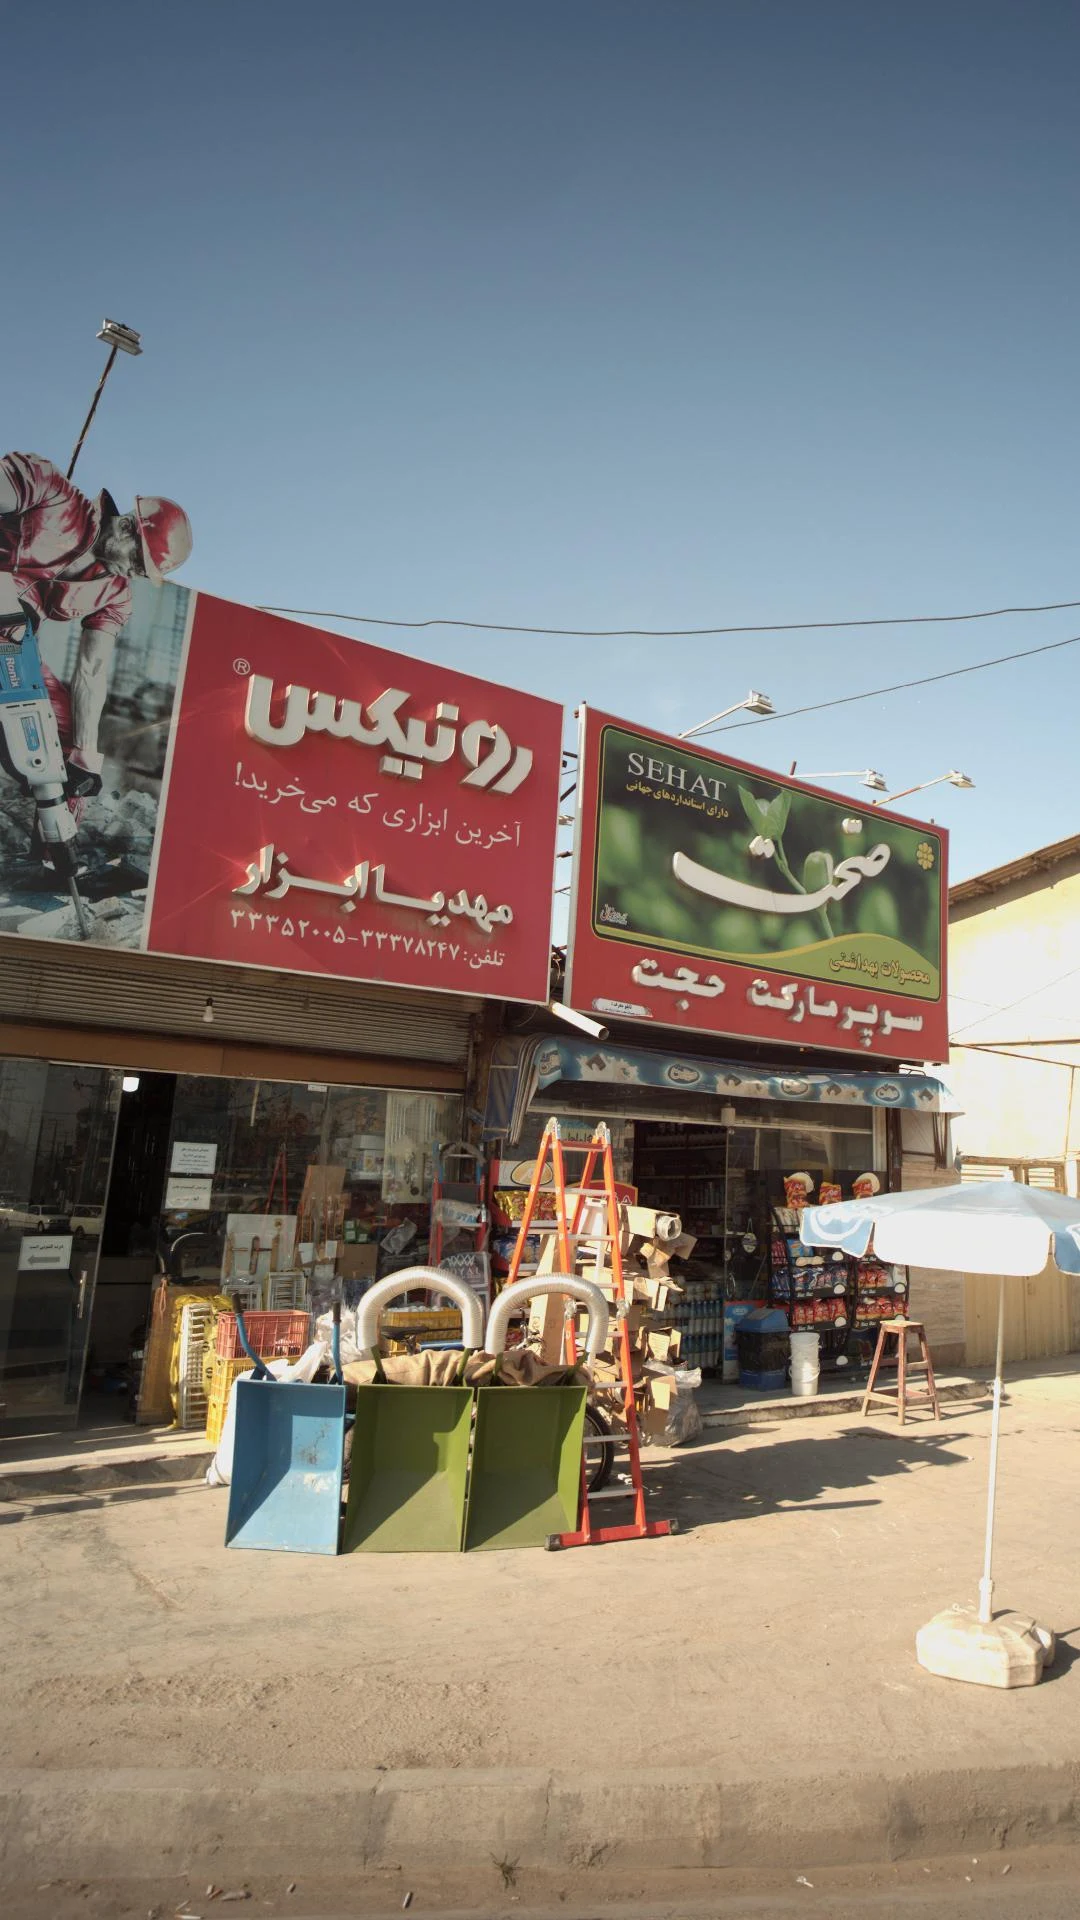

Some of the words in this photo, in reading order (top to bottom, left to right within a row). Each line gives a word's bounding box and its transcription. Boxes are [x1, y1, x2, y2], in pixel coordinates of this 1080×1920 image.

[6, 656, 20, 688] Ronix
[244, 673, 533, 794] رونیکس
[625, 780, 653, 797] جهانی
[627, 752, 727, 801] SEHAT
[347, 792, 379, 814] که
[706, 804, 729, 819] دارای
[382, 803, 448, 836] ابزاری
[455, 821, 520, 849] آخرین
[231, 843, 370, 913] ابزار
[371, 863, 514, 933] مهدیا
[829, 951, 879, 979] بهداشتی
[880, 959, 931, 985] محصولات
[631, 957, 726, 1011] حجت
